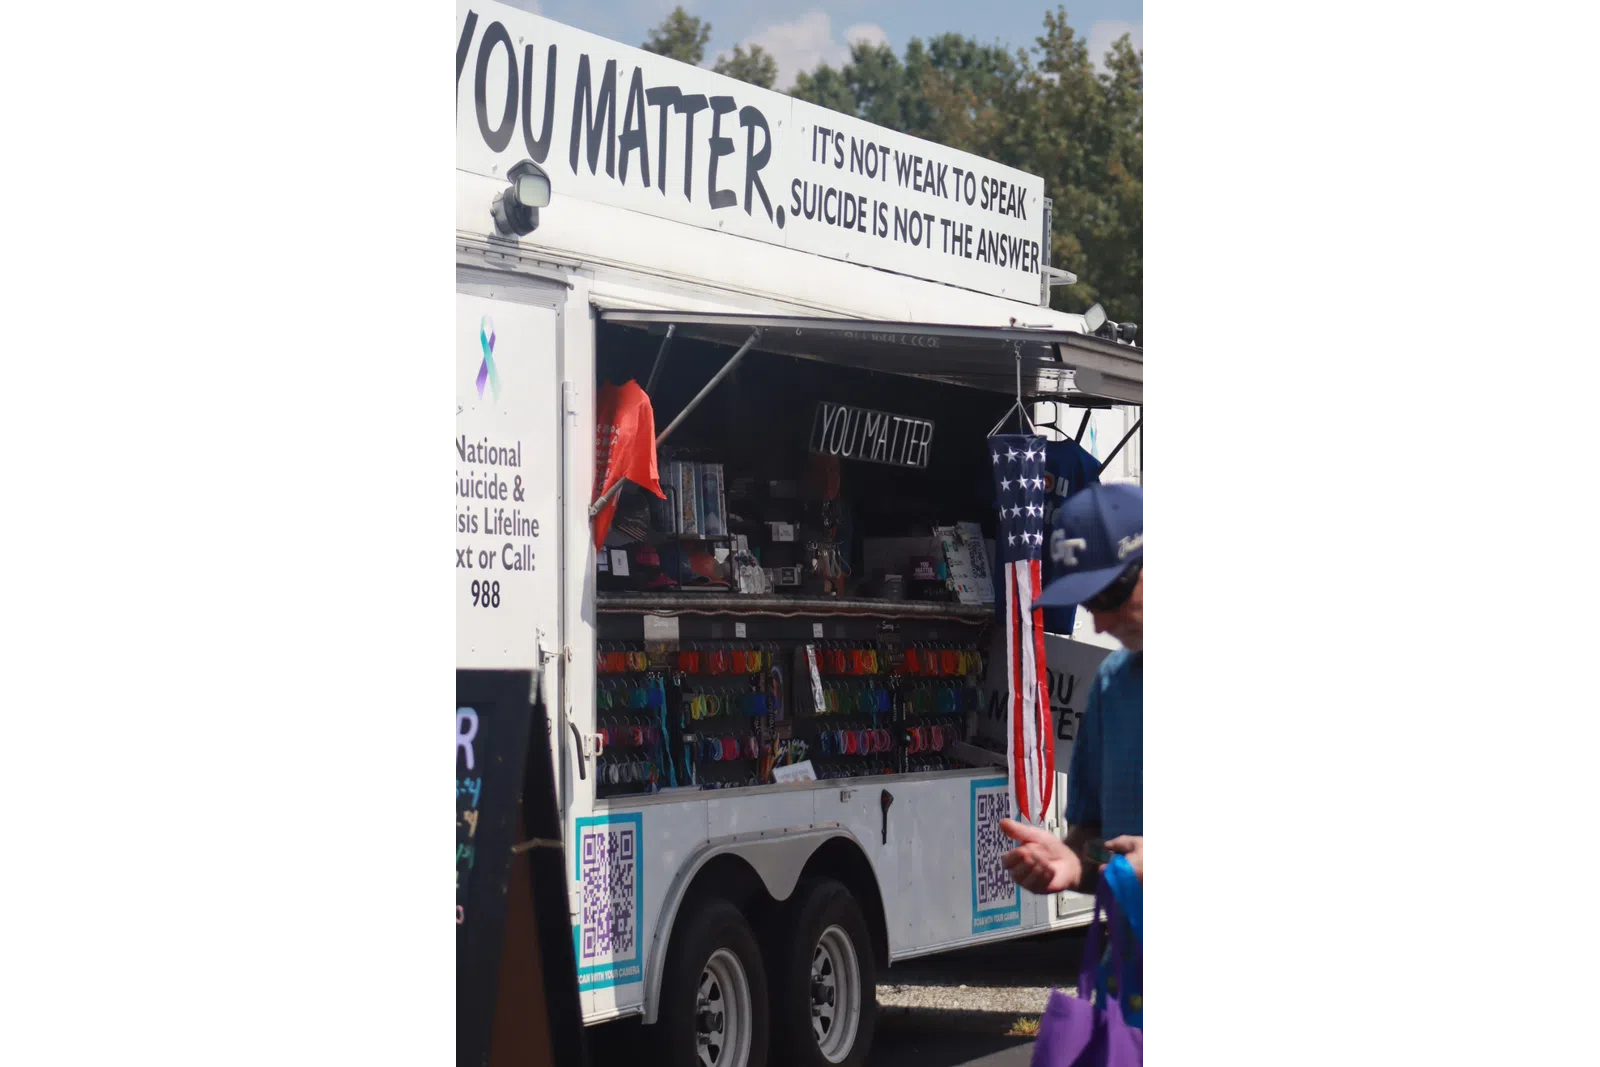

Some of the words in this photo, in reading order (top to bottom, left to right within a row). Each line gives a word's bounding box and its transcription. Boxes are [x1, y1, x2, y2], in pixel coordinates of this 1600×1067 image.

[569, 53, 785, 229] MATTER.
[812, 125, 845, 169] IT'S
[850, 136, 890, 182] NOT
[894, 150, 948, 199] WEAK
[952, 167, 976, 206] TO
[980, 175, 1027, 220] SPEAK
[790, 178, 867, 233] SUICIDE
[873, 200, 888, 238] IS
[894, 206, 935, 249] NOT
[940, 218, 972, 259] THE
[976, 228, 1039, 274] ANSWER
[456, 434, 521, 467] National
[820, 404, 860, 456] YOU
[859, 411, 933, 467] MATTER
[513, 475, 525, 502] &
[484, 507, 539, 538] Lifeline
[478, 550, 496, 569] or
[502, 543, 535, 571] Call:
[471, 580, 500, 608] 988
[591, 971, 605, 983] WITH
[605, 968, 619, 981] YOUR
[619, 965, 640, 977] CAMERA
